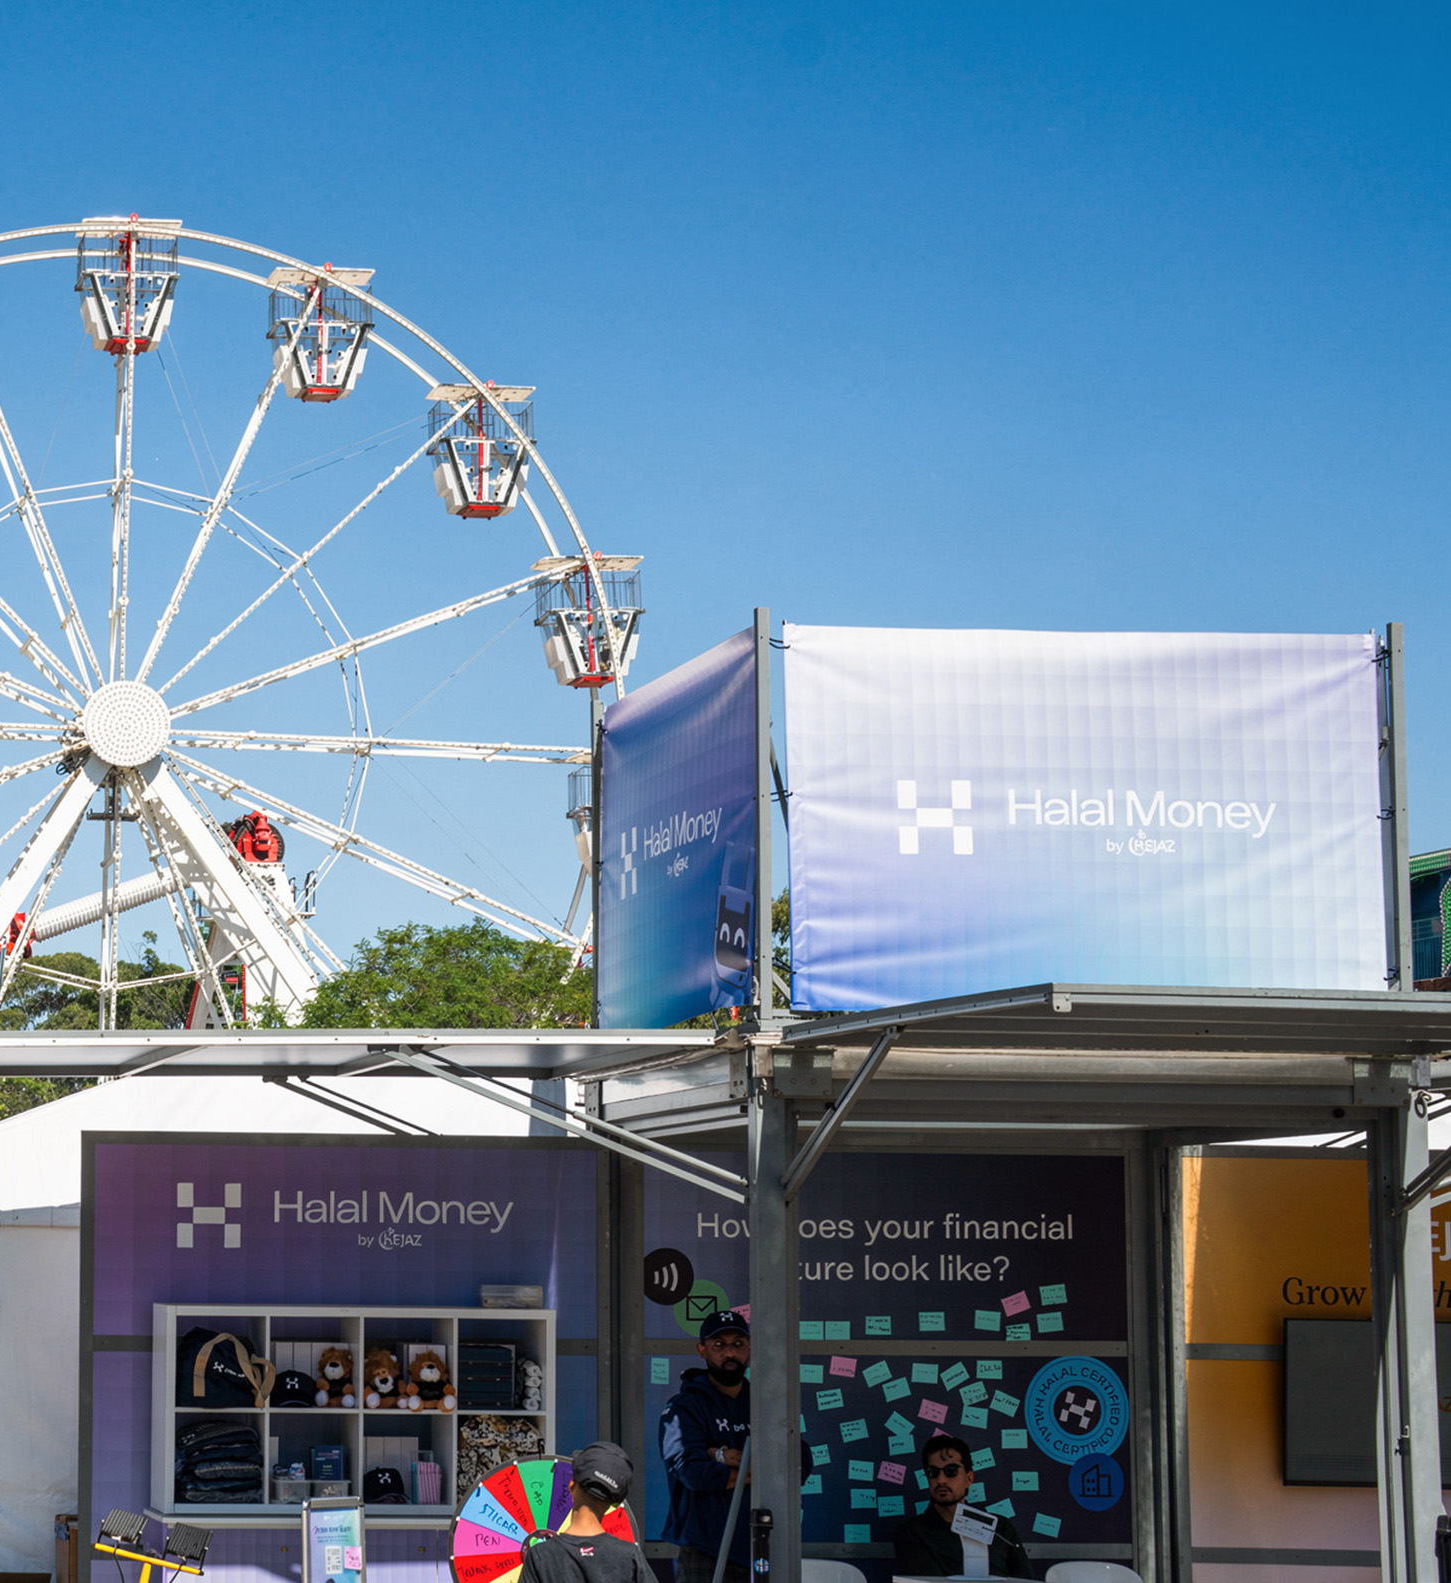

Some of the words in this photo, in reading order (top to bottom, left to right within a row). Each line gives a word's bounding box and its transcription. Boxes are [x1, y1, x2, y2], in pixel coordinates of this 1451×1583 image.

[1007, 788, 1114, 827] Halal
[1125, 789, 1277, 840] Money
[643, 815, 672, 861] Halal
[674, 807, 723, 844] Money
[1106, 838, 1124, 855] by
[273, 1190, 368, 1224] Halal
[379, 1190, 514, 1234] Money
[357, 1233, 375, 1248] by
[798, 1219, 855, 1239] oes
[863, 1218, 935, 1246] your
[943, 1213, 1074, 1240] financial
[798, 1261, 855, 1282] ure
[864, 1255, 930, 1282] look
[939, 1255, 1011, 1282] like?
[1282, 1276, 1367, 1306] Grow
[1039, 1366, 1078, 1396] HALAL
[1080, 1367, 1121, 1426] CERTIFIED
